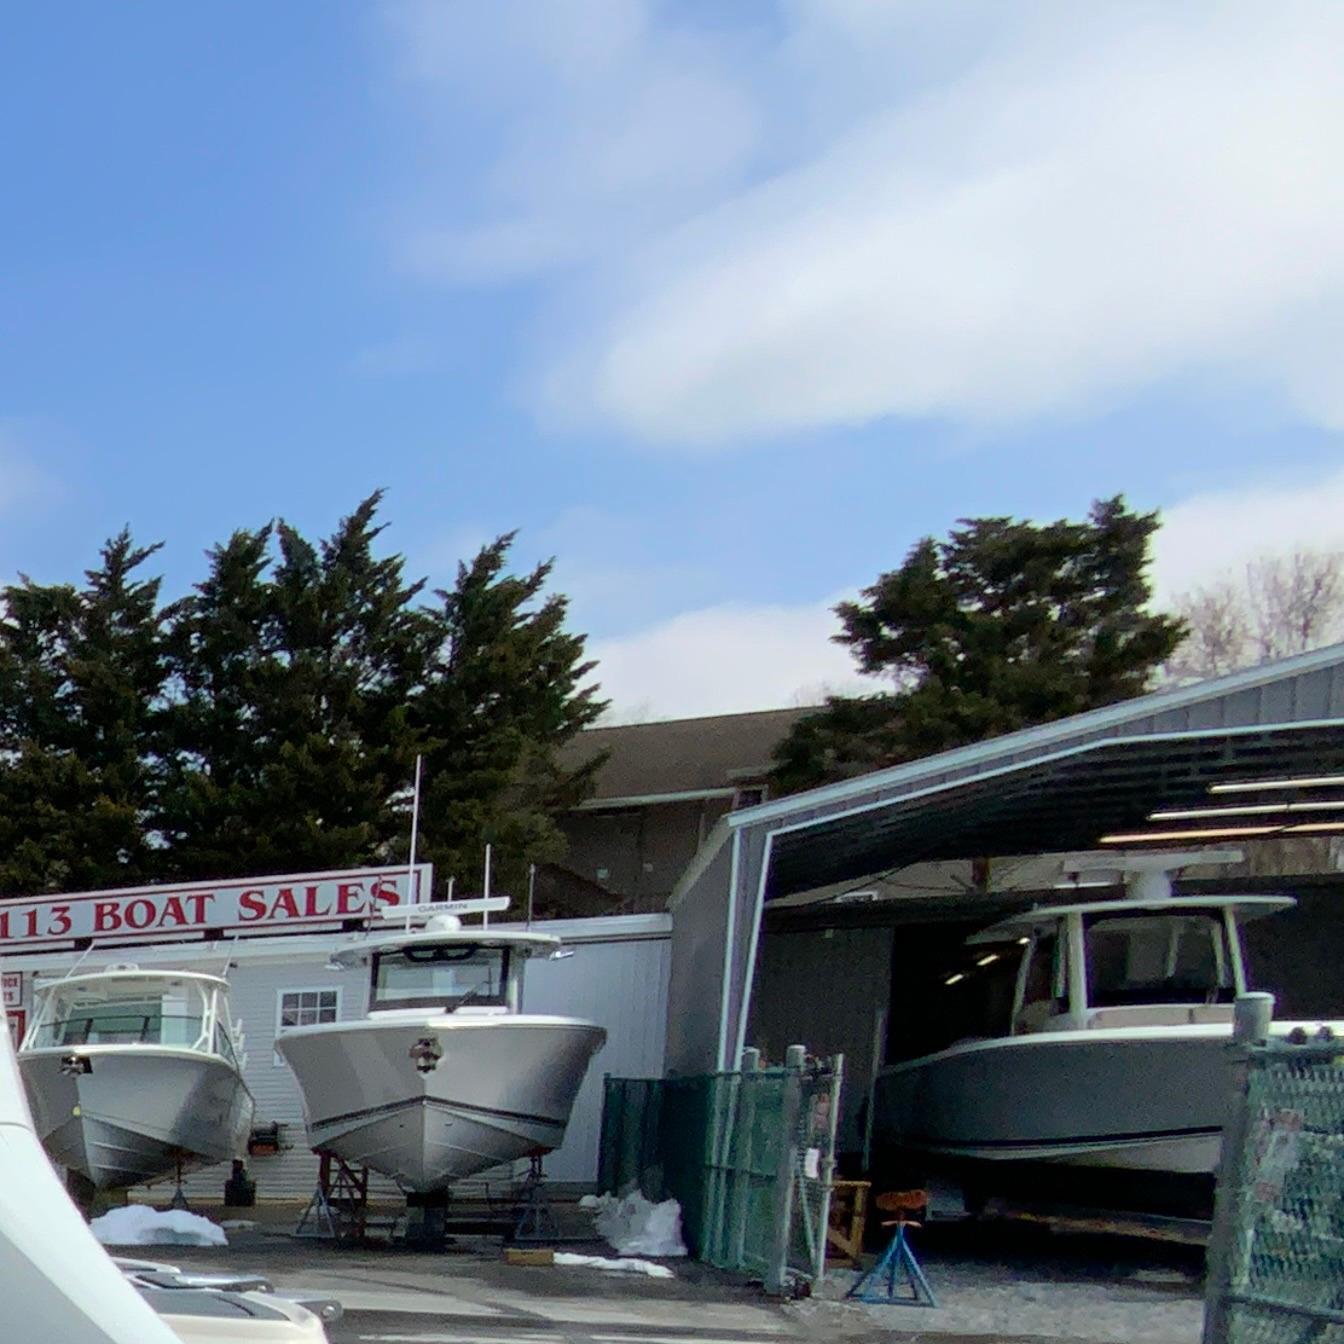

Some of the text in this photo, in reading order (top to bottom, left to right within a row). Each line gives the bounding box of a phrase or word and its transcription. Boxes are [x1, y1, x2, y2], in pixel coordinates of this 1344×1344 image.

[93, 893, 215, 932] BOAT
[238, 879, 401, 922] SALES
[417, 902, 468, 913] GARMIN
